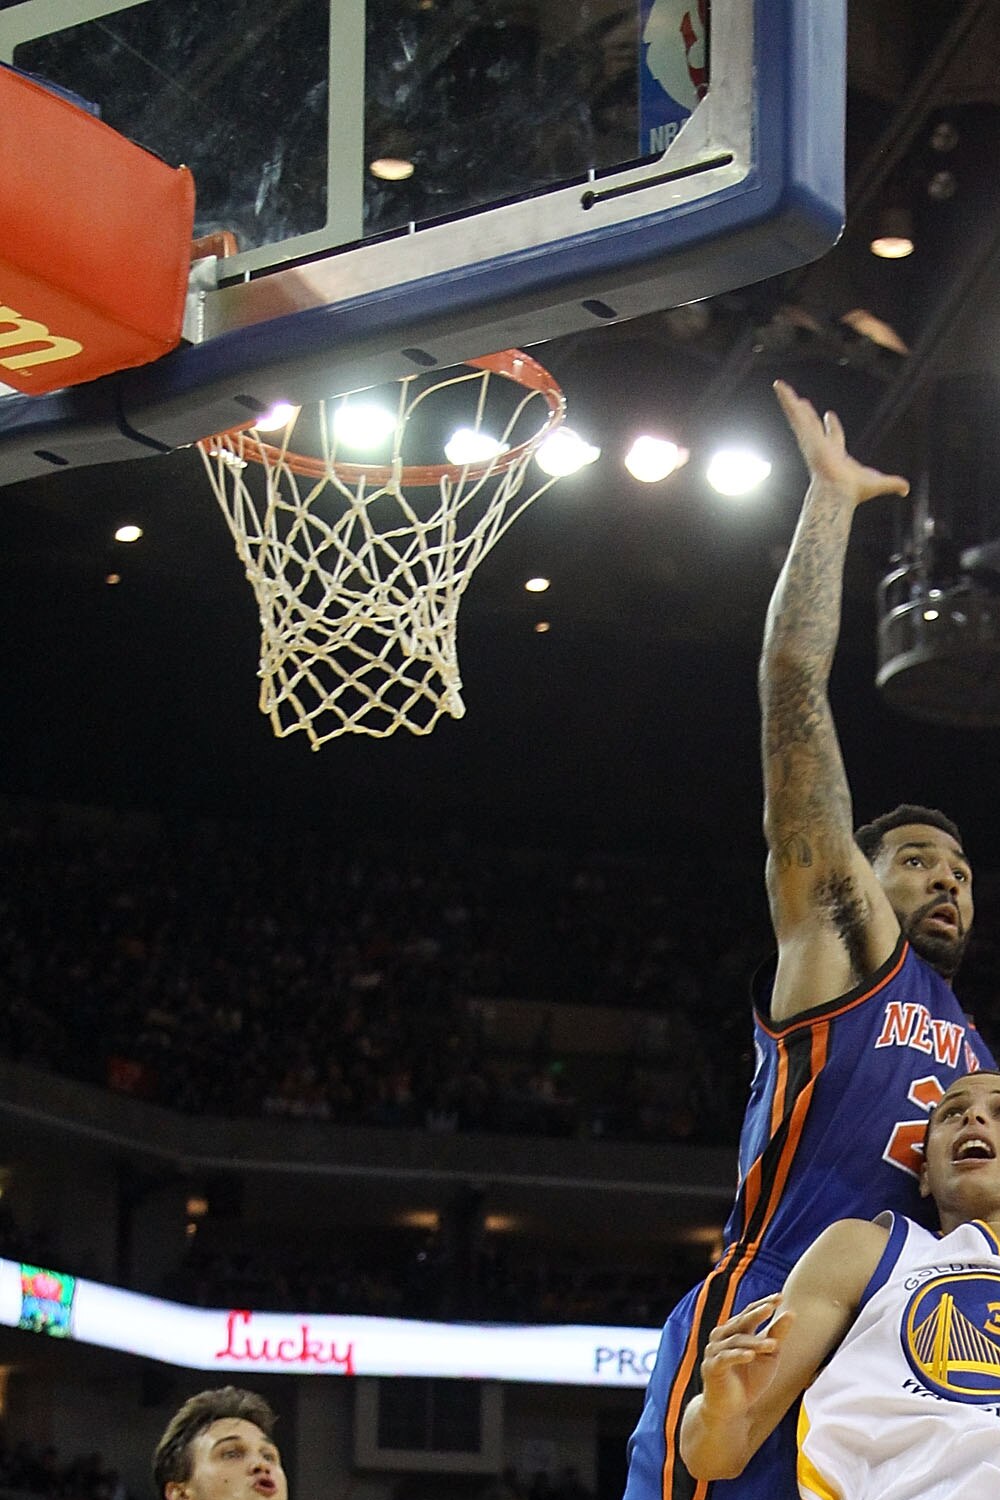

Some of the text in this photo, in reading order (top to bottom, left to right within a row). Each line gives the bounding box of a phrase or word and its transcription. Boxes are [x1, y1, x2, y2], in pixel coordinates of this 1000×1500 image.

[650, 118, 691, 154] NB
[875, 1001, 965, 1069] NEW
[215, 1309, 354, 1376] Lucky
